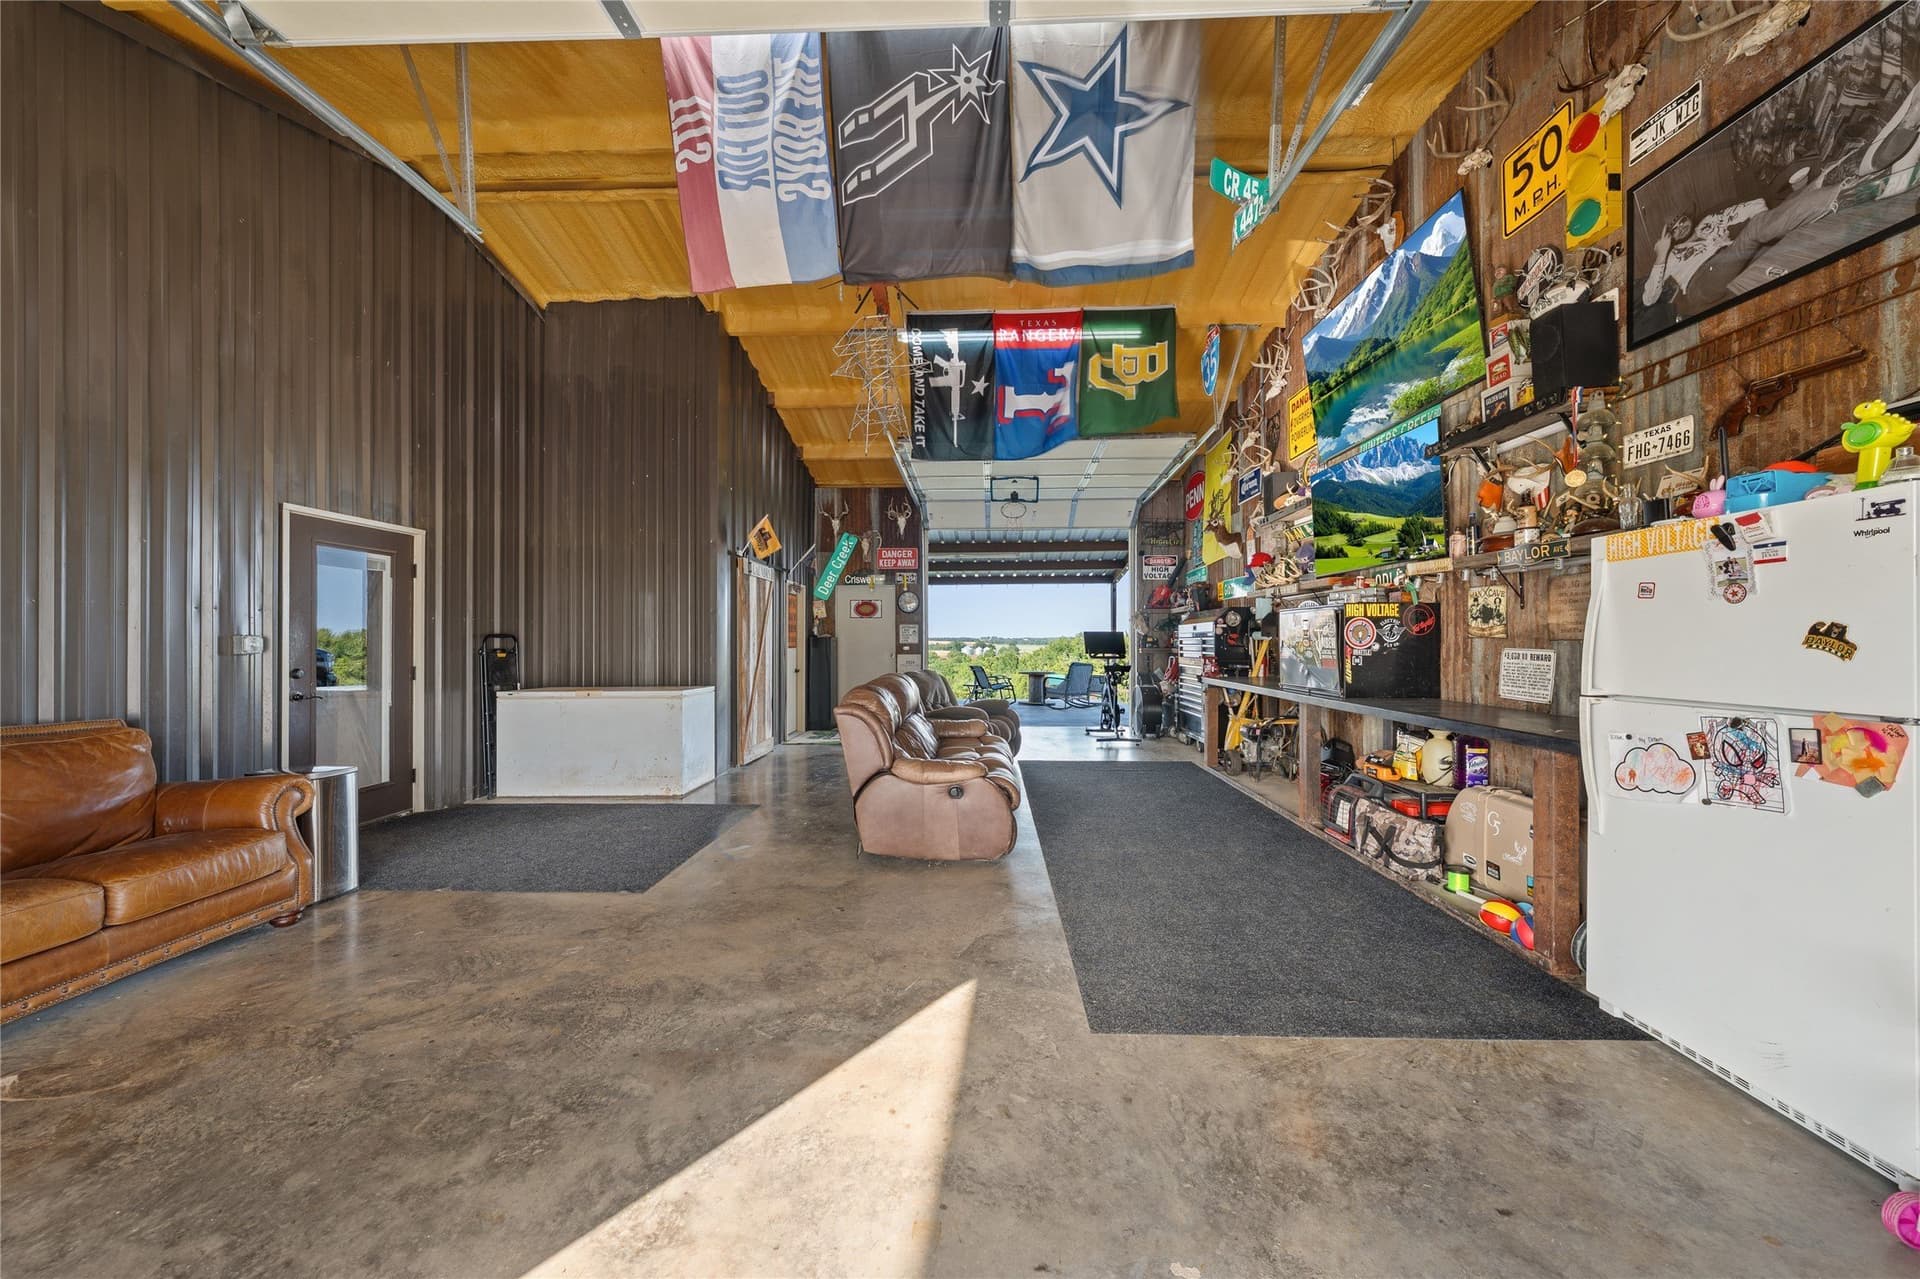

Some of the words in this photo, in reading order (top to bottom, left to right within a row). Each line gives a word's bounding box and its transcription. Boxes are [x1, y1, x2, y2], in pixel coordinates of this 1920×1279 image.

[1512, 124, 1563, 197] 50
[1223, 167, 1240, 198] CR
[1019, 319, 1058, 327] TEXAS
[911, 327, 924, 366] COME
[914, 367, 926, 397] AND
[1291, 391, 1310, 414] DANG
[914, 398, 926, 433] TAKE
[915, 434, 926, 448] IT
[1644, 424, 1672, 438] TEXAS
[1185, 481, 1205, 512] PENN
[1853, 527, 1890, 538] Whirlpool
[881, 550, 913, 558] DANGER
[1504, 544, 1550, 563] BAYLOR
[1609, 531, 1641, 560] HIGH
[817, 570, 838, 596] Deer
[831, 538, 854, 569] Creek
[879, 559, 896, 567] KEEP
[897, 559, 916, 567] AWAY
[1345, 603, 1365, 617] HIGH
[1366, 603, 1399, 617] VOLTAGE
[1806, 634, 1853, 660] BAYLOR
